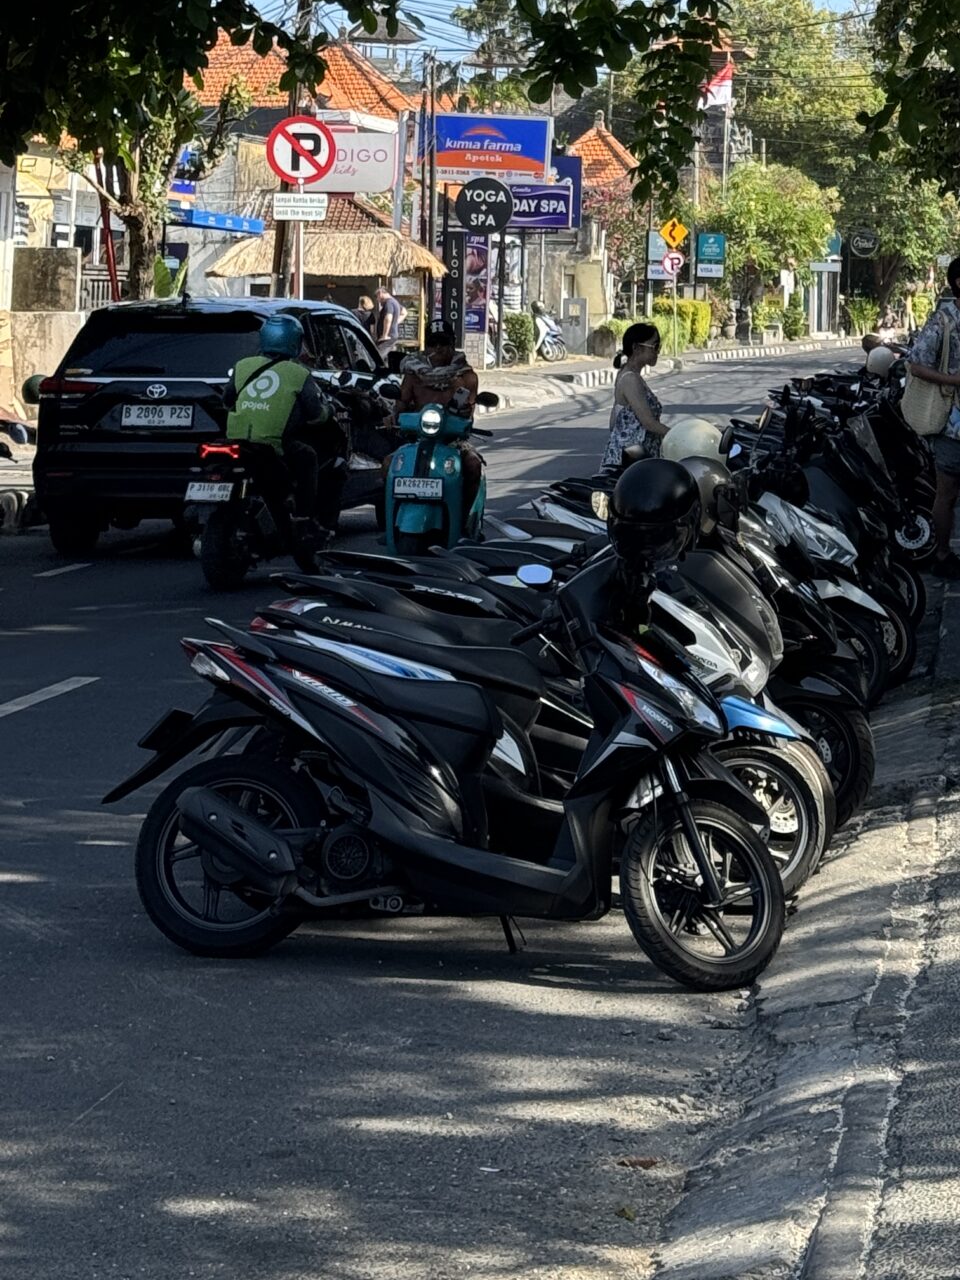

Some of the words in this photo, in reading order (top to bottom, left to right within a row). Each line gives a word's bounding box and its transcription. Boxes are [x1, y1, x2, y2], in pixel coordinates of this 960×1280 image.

[445, 137, 480, 150] kimia
[482, 138, 522, 152] farma
[337, 148, 388, 163] DIGO
[464, 152, 503, 163] Apotek
[464, 188, 507, 203] YOGA
[512, 198, 538, 213] DAY
[540, 199, 567, 214] SPA
[470, 213, 496, 227] SPA
[124, 406, 132, 419] B
[170, 406, 191, 419] PZS
[241, 398, 270, 412] gojek
[641, 704, 674, 733] HONDA
